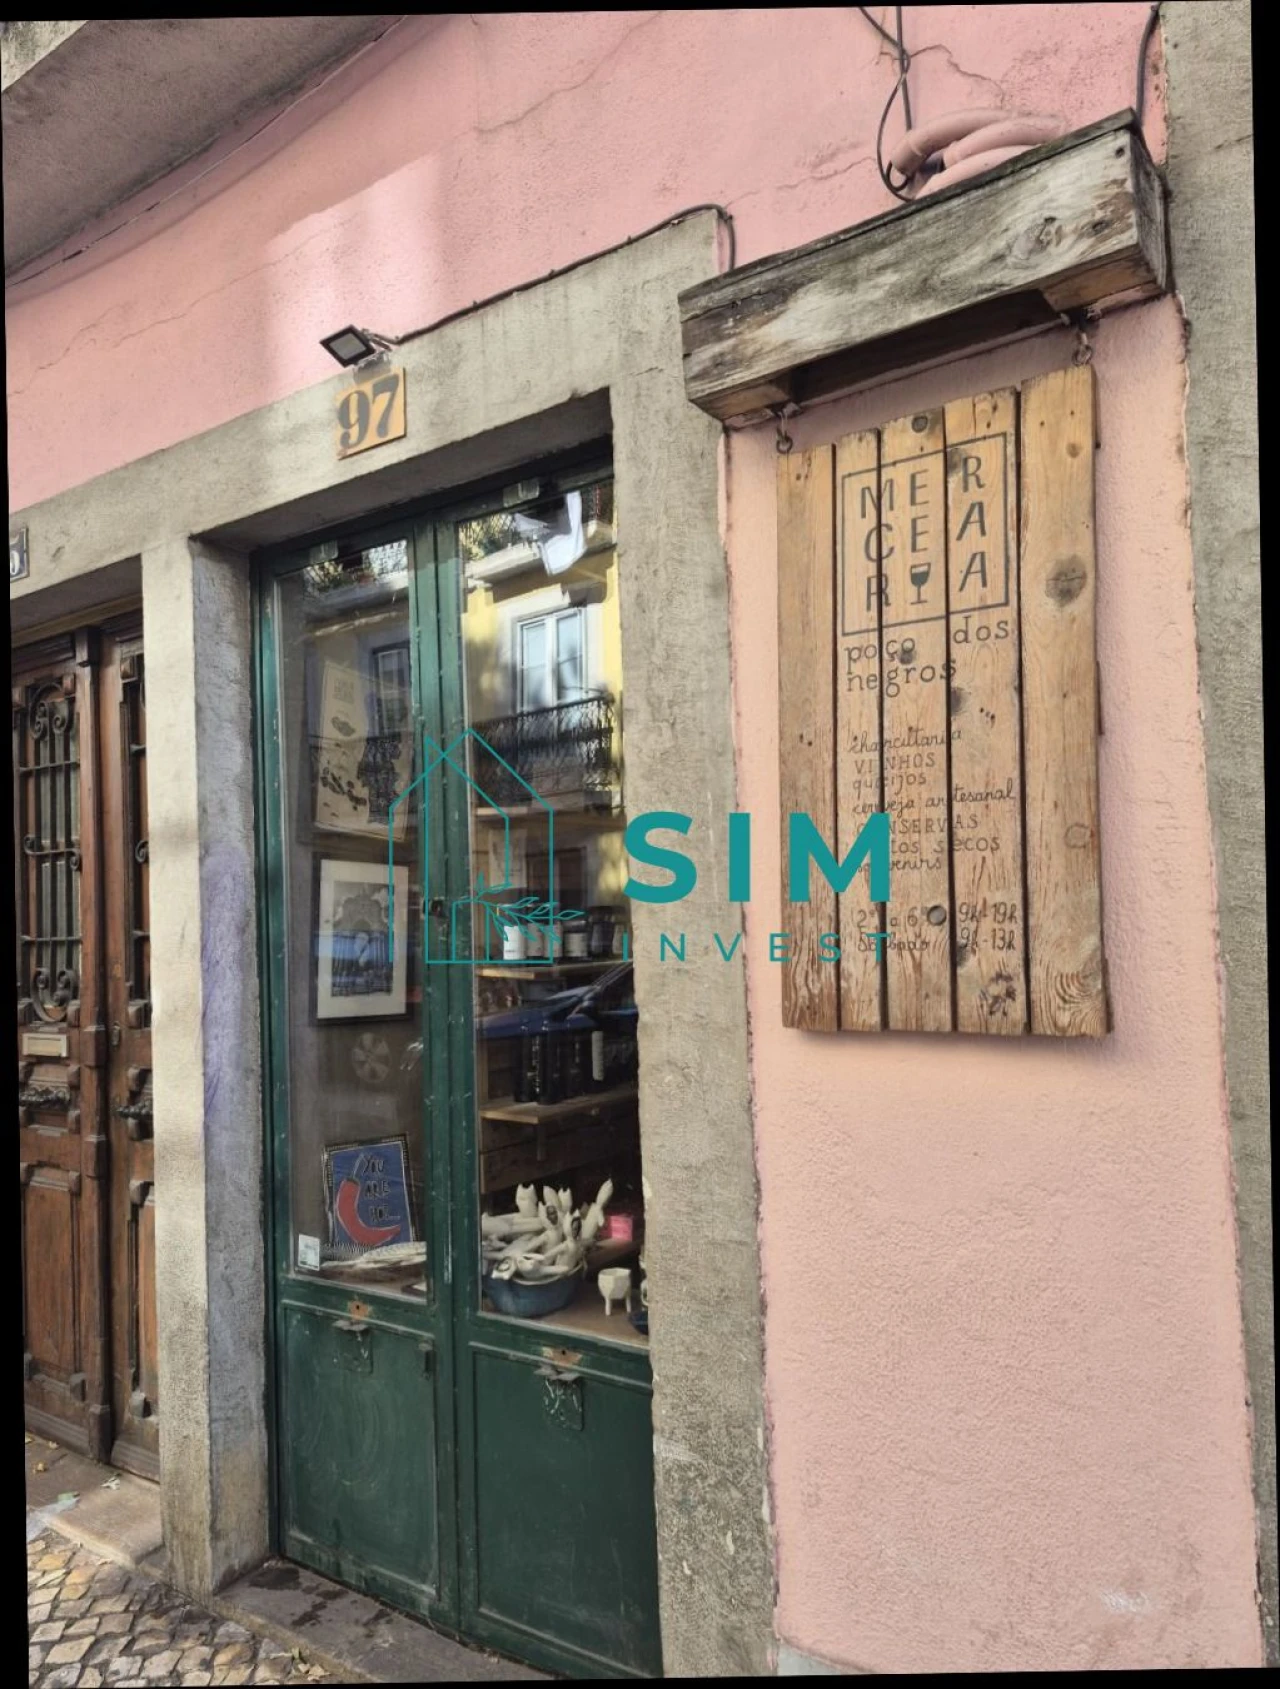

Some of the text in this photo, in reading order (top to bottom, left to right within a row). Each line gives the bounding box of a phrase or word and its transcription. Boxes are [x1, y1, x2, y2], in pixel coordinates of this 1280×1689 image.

[338, 374, 400, 447] 97
[844, 615, 1009, 671] poço dos
[846, 657, 957, 698] negros
[854, 751, 936, 775] VINHOS
[932, 836, 1000, 855] secos
